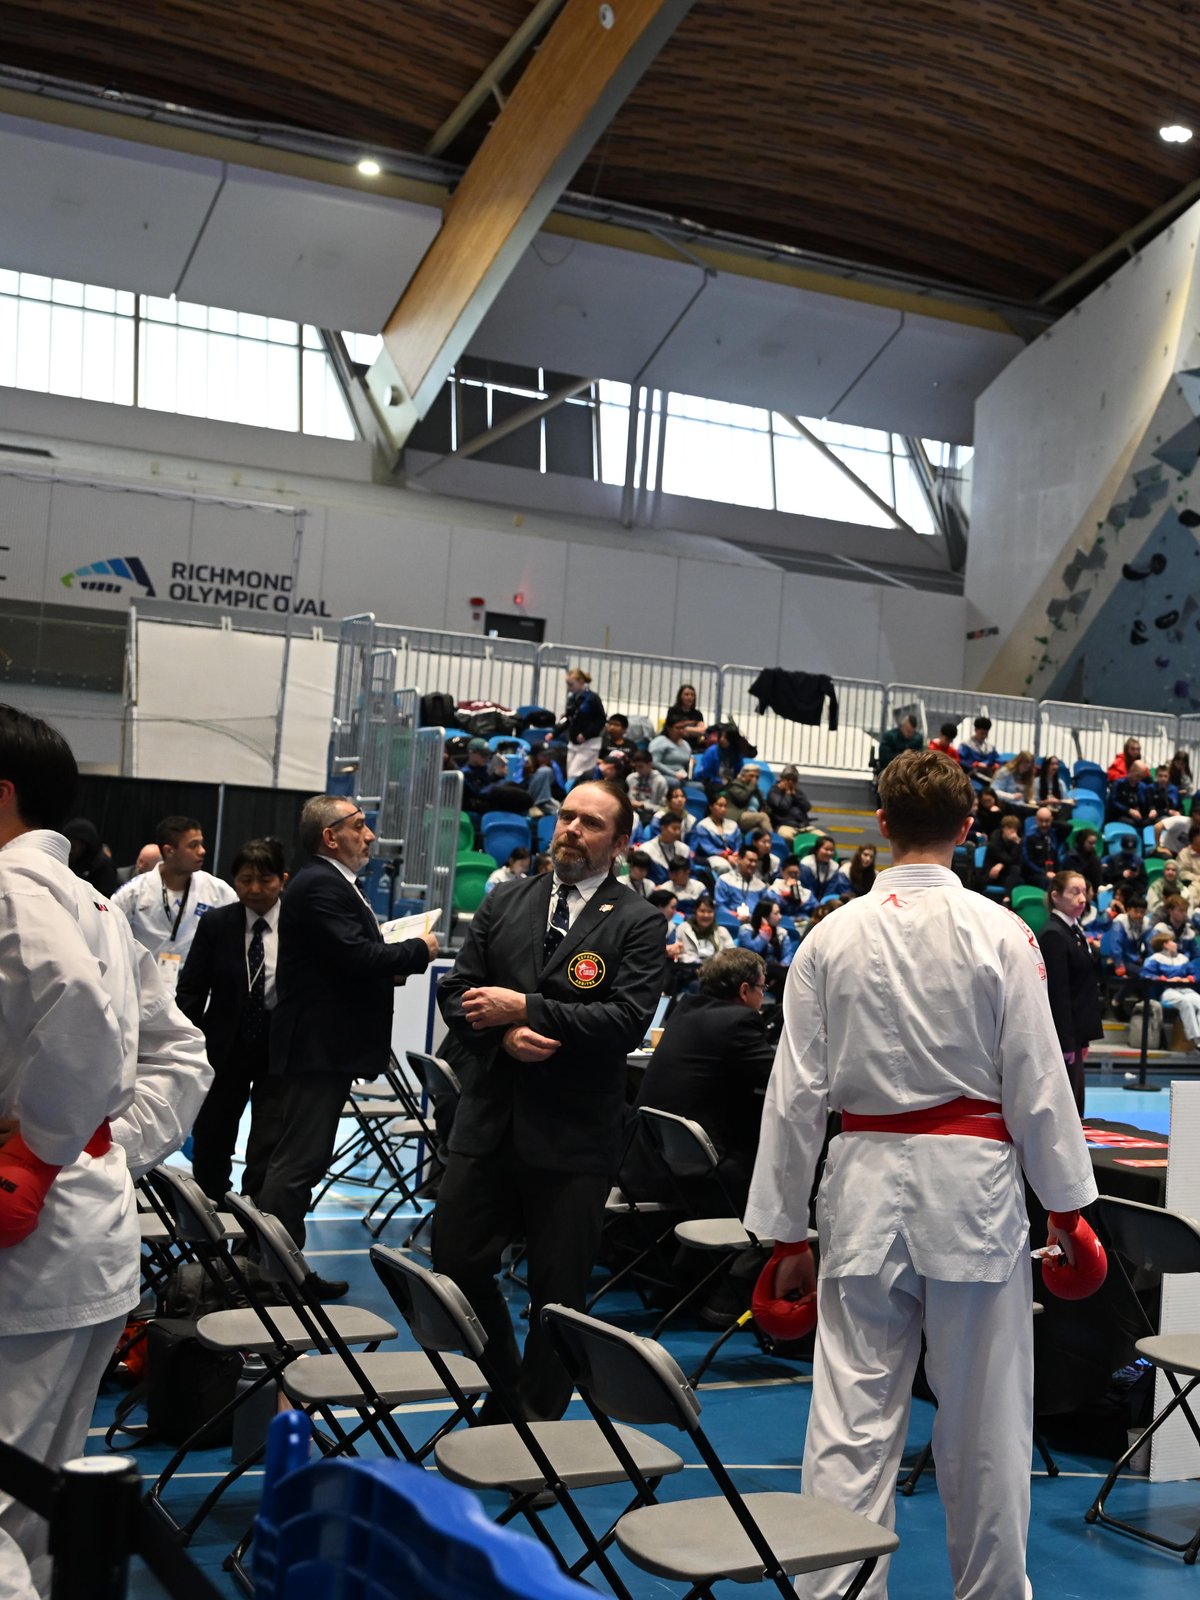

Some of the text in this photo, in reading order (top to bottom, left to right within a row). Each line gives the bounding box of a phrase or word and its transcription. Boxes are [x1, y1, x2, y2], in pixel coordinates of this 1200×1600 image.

[171, 562, 293, 592] RICHMOND
[169, 583, 332, 617] OLYMPIC OVAL
